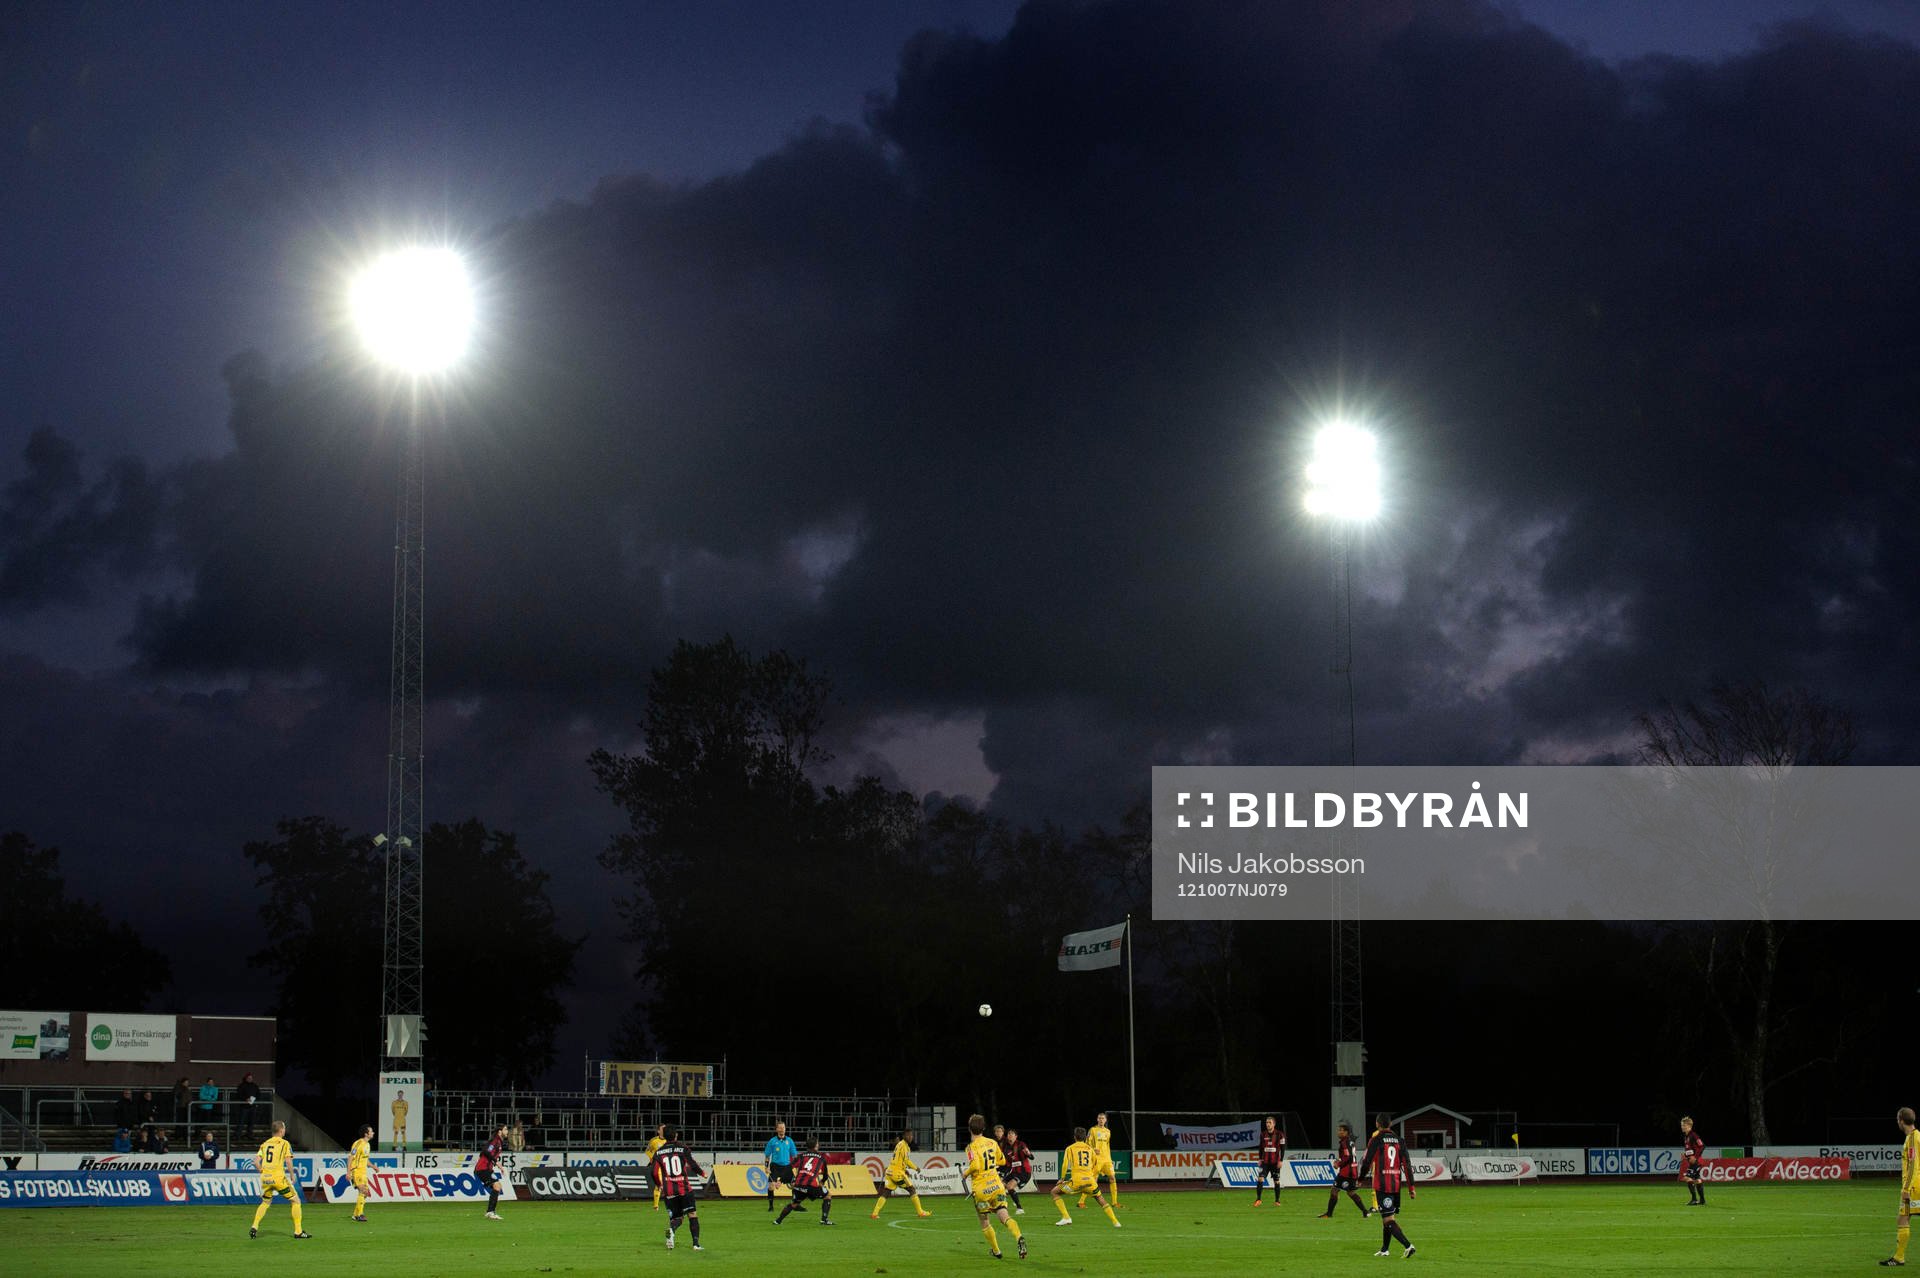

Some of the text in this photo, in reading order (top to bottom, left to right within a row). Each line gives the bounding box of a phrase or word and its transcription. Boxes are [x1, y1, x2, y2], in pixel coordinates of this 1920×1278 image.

[386, 1077, 417, 1085] PEAB
[606, 1064, 646, 1094] ÄFF
[668, 1066, 706, 1096] ÄFF
[1180, 1130, 1255, 1145] INTERSPORT
[266, 1146, 274, 1163] 6
[983, 1149, 995, 1170] 15
[1078, 1151, 1089, 1167] 13
[1134, 1153, 1258, 1168] HAMNKROGE
[1387, 1146, 1396, 1167] 9
[1591, 1151, 1648, 1172] KÖKS
[1820, 1148, 1902, 1160] Rörservice
[662, 1155, 682, 1176] 10
[804, 1157, 814, 1171] 4
[1534, 1160, 1575, 1173] TNERS
[1700, 1161, 1841, 1180] decco Adecco
[1294, 1165, 1335, 1181] RIMPAC
[14, 1178, 151, 1198] FOTBOLLSKLUBB
[532, 1171, 616, 1196] adidas
